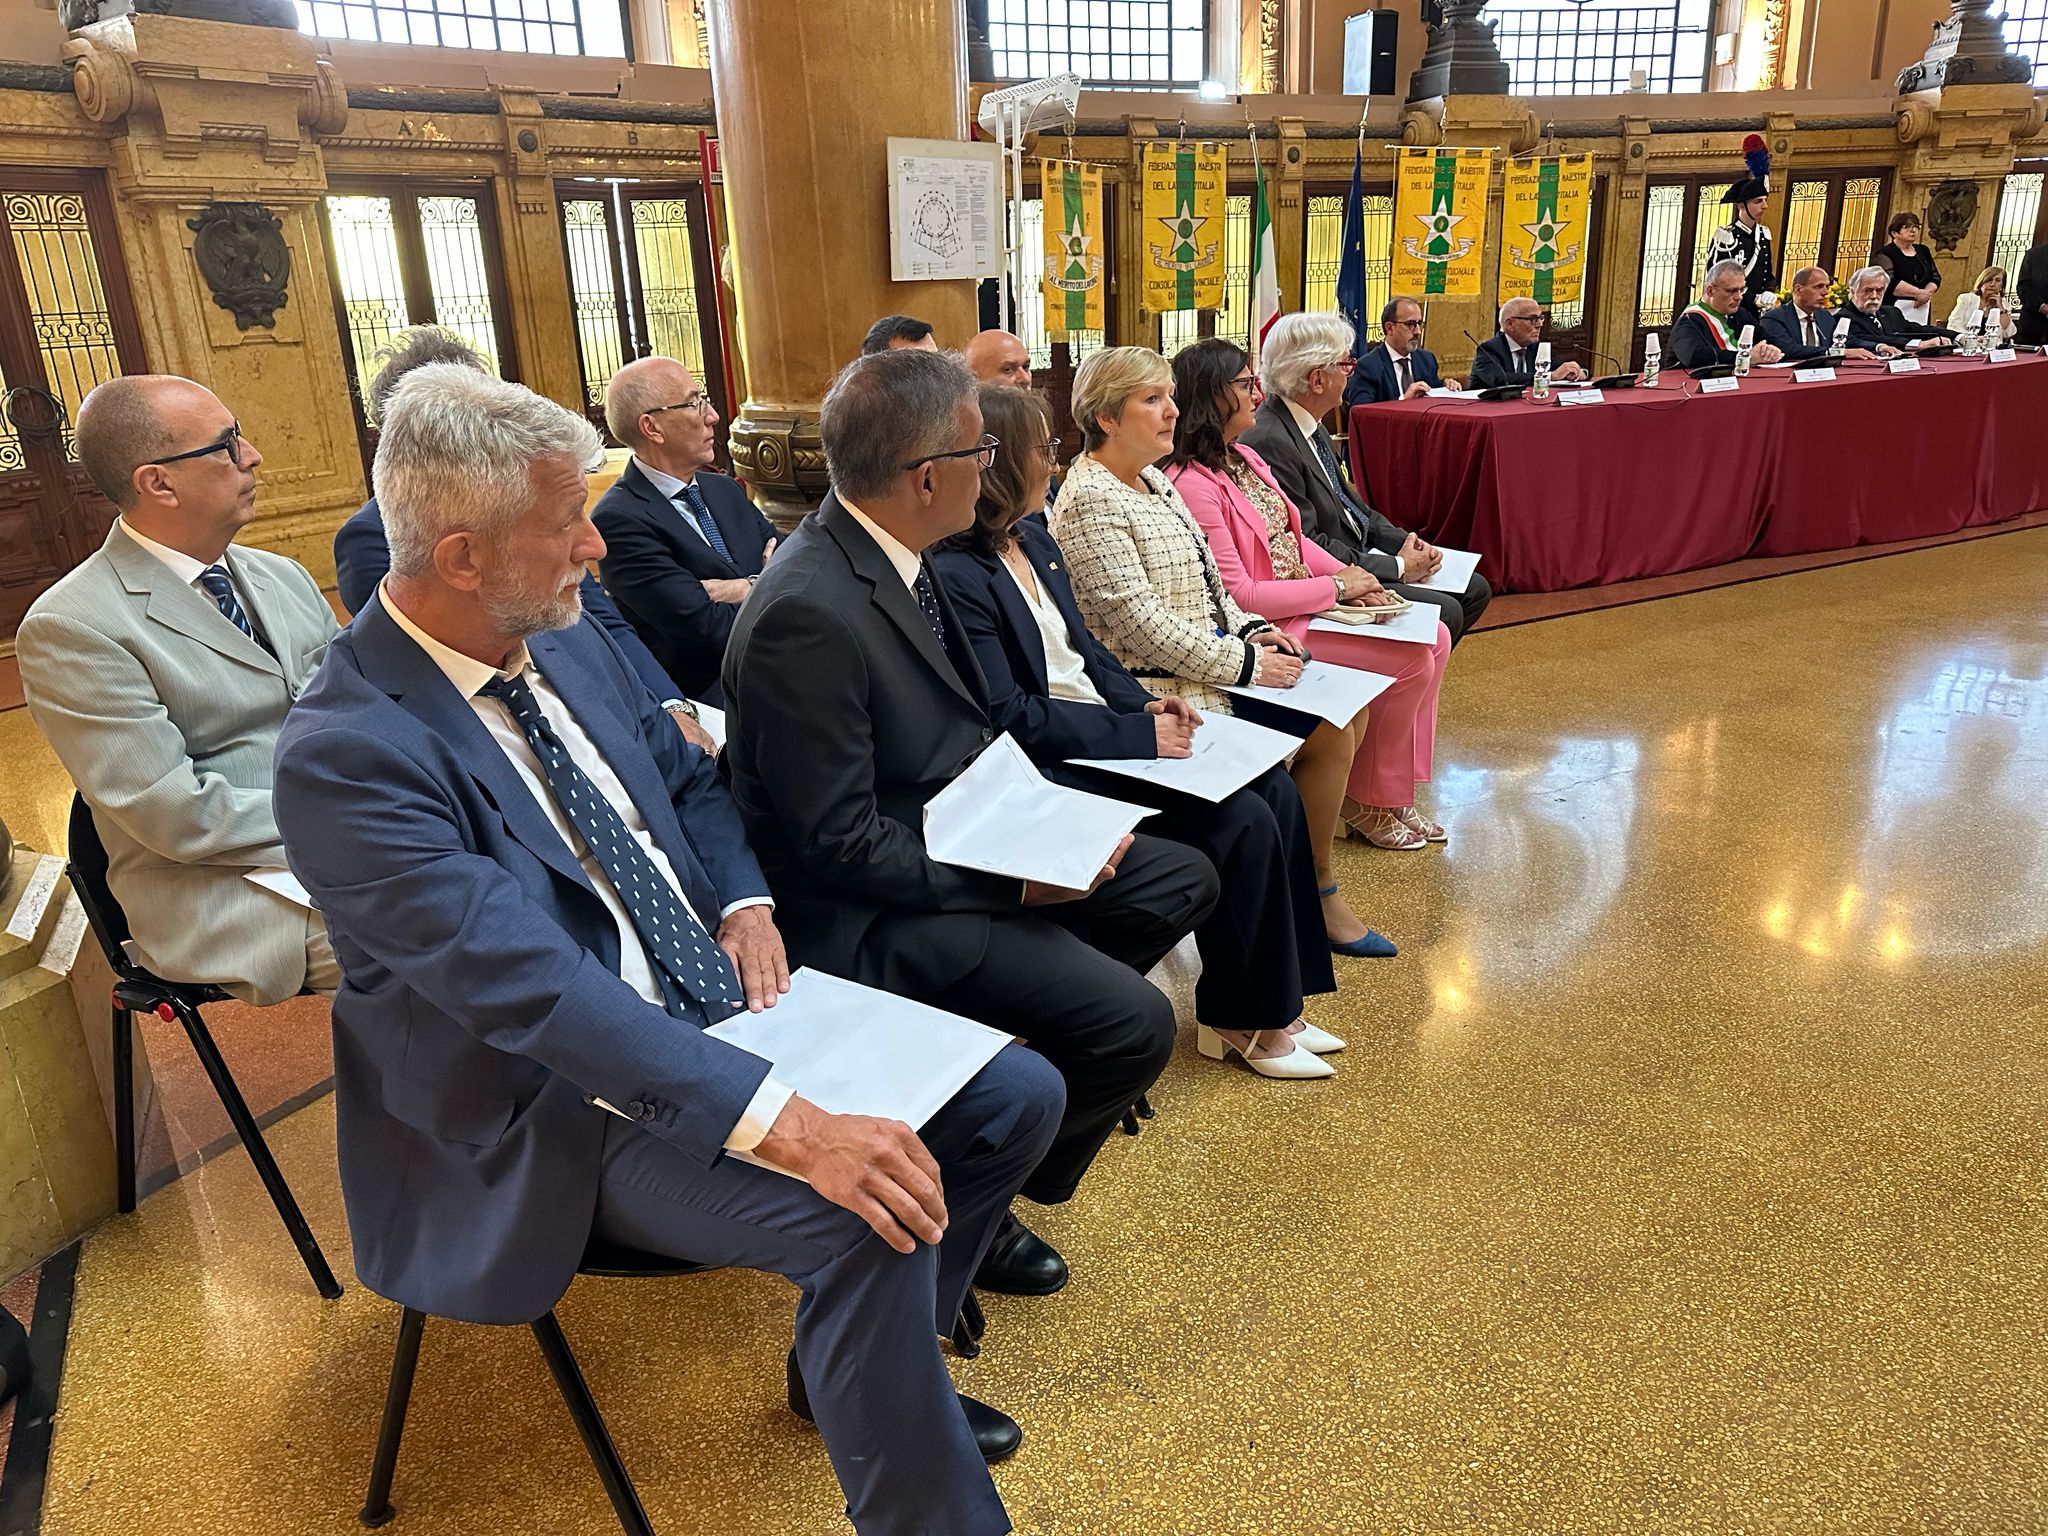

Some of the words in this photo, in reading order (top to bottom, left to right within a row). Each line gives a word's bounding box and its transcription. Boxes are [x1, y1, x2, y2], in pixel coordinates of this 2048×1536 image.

[398, 120, 412, 135] A
[628, 131, 638, 145] B
[1702, 138, 1709, 149] H
[1148, 161, 1185, 171] FEDERAZ
[1460, 166, 1485, 175] MAESTRI
[1153, 181, 1165, 190] DEL
[1411, 182, 1423, 190] DEL
[1515, 192, 1527, 201] DEL
[1149, 280, 1182, 290] CONSOLA
[1184, 277, 1220, 288] VINCIALE
[1505, 279, 1540, 288] CONSOLA
[1544, 275, 1581, 286] VINCIALE
